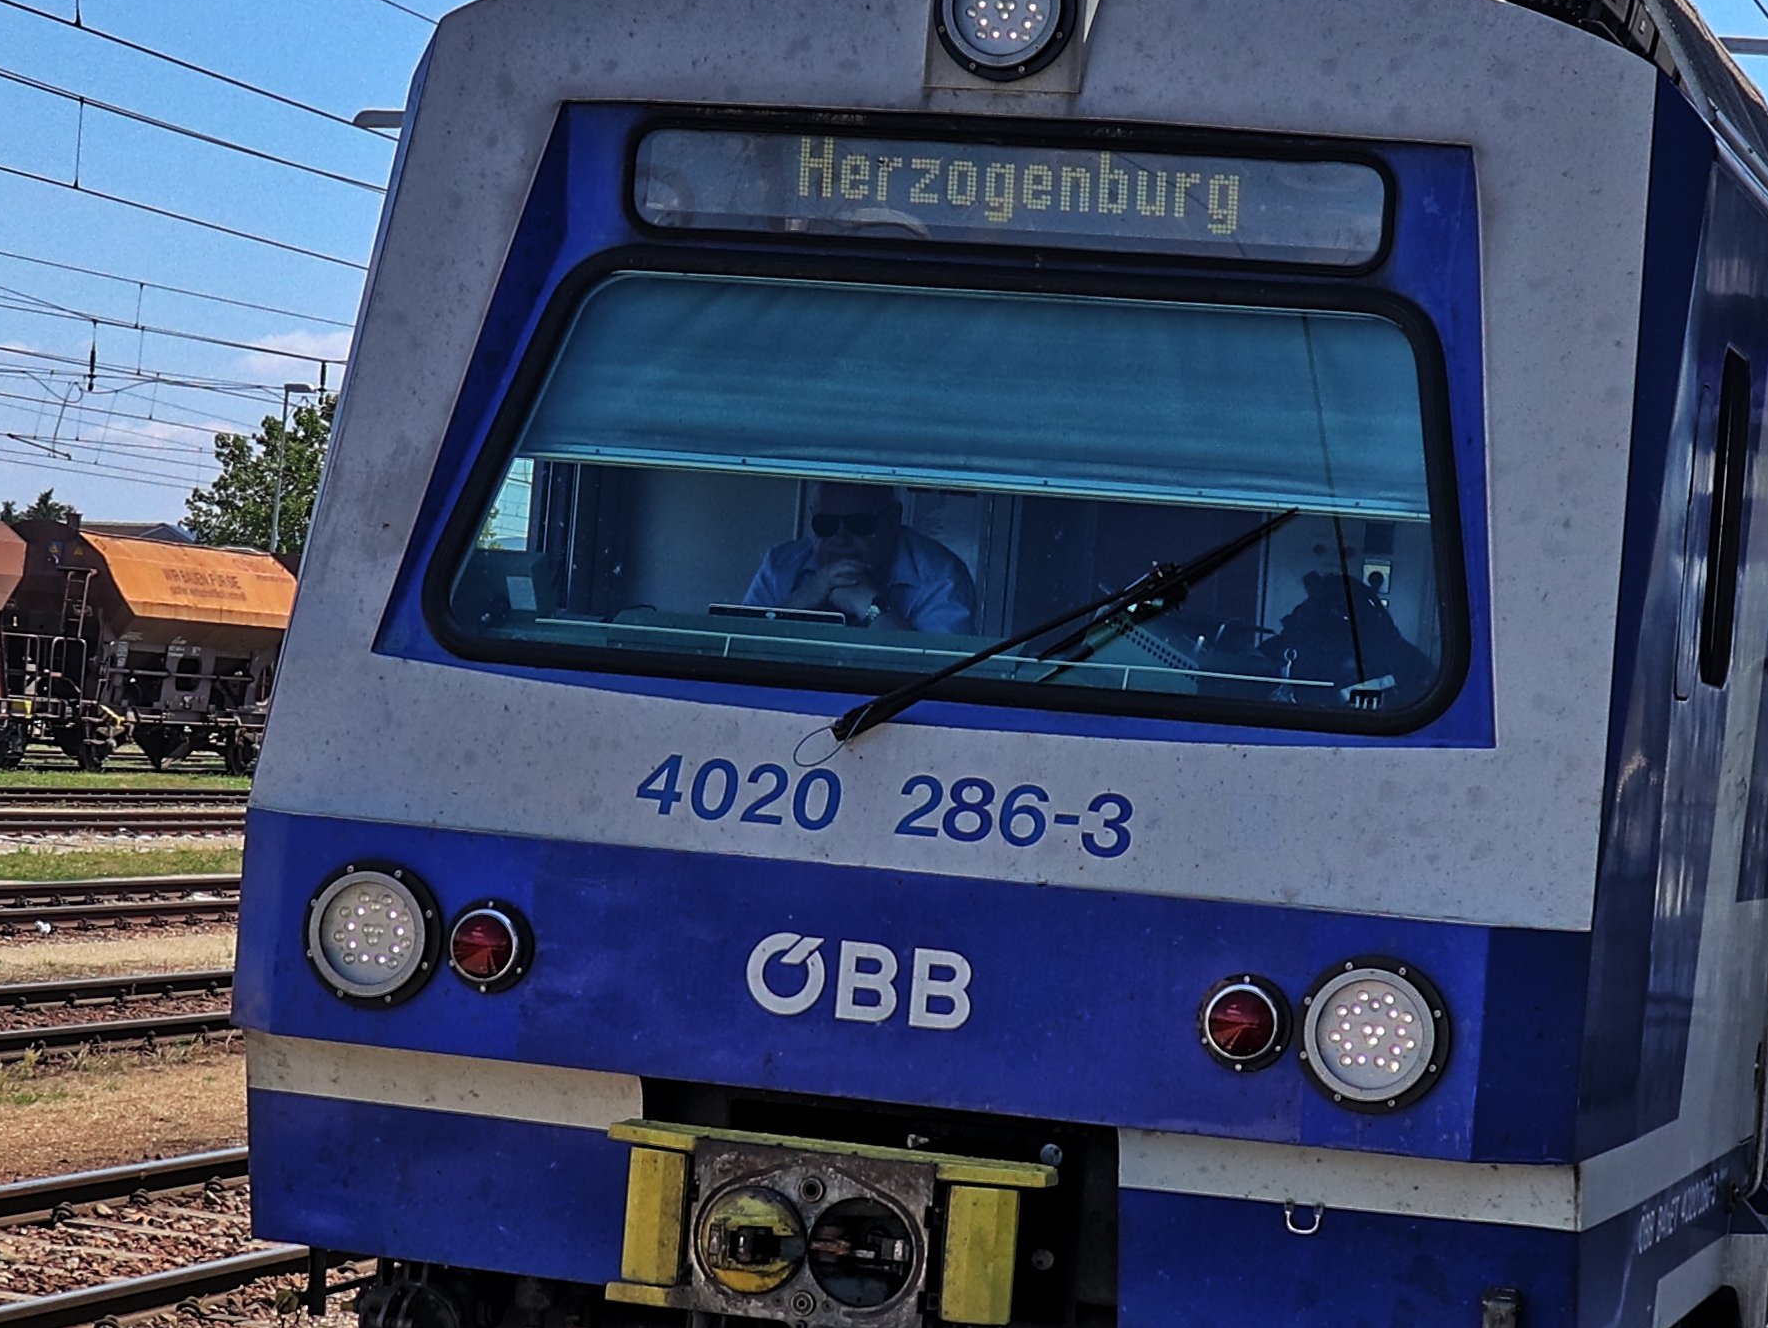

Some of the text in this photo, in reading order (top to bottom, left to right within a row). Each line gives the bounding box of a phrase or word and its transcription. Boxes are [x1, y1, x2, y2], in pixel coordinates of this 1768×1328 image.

[798, 134, 1241, 236] Herzogenburg
[635, 751, 1137, 858] 4020 286-3
[744, 931, 974, 1032] ÖBB
